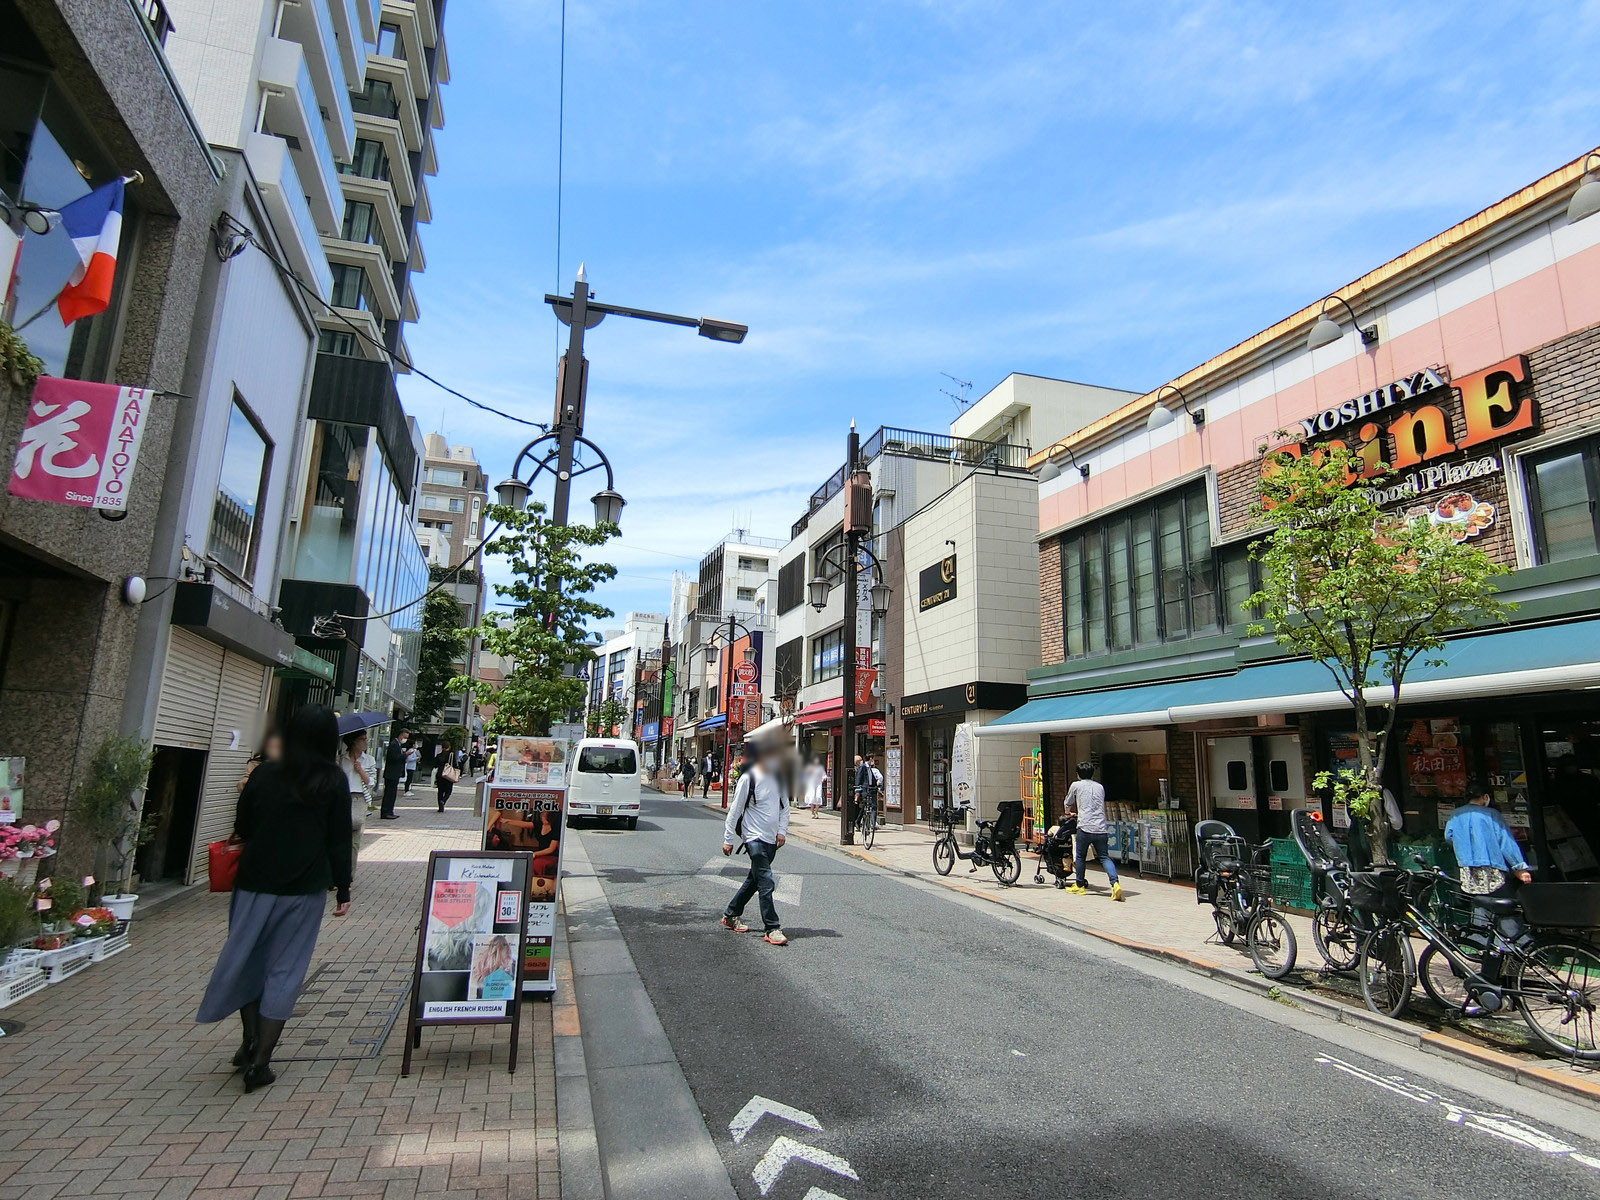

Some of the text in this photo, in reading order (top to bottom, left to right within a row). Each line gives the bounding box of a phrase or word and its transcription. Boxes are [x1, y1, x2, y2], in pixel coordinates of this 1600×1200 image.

[1299, 367, 1444, 438] YOSHIYA
[14, 400, 100, 480] 花
[106, 386, 144, 494] HANATOYO
[1420, 456, 1500, 492] Plaza
[65, 491, 122, 506] Since 1835
[921, 589, 950, 608] CENTURY 21
[901, 704, 922, 716] CENTURY
[923, 703, 928, 712] 21
[495, 798, 559, 812] Baan Rak
[501, 906, 512, 916] 30
[526, 948, 542, 957] 5F
